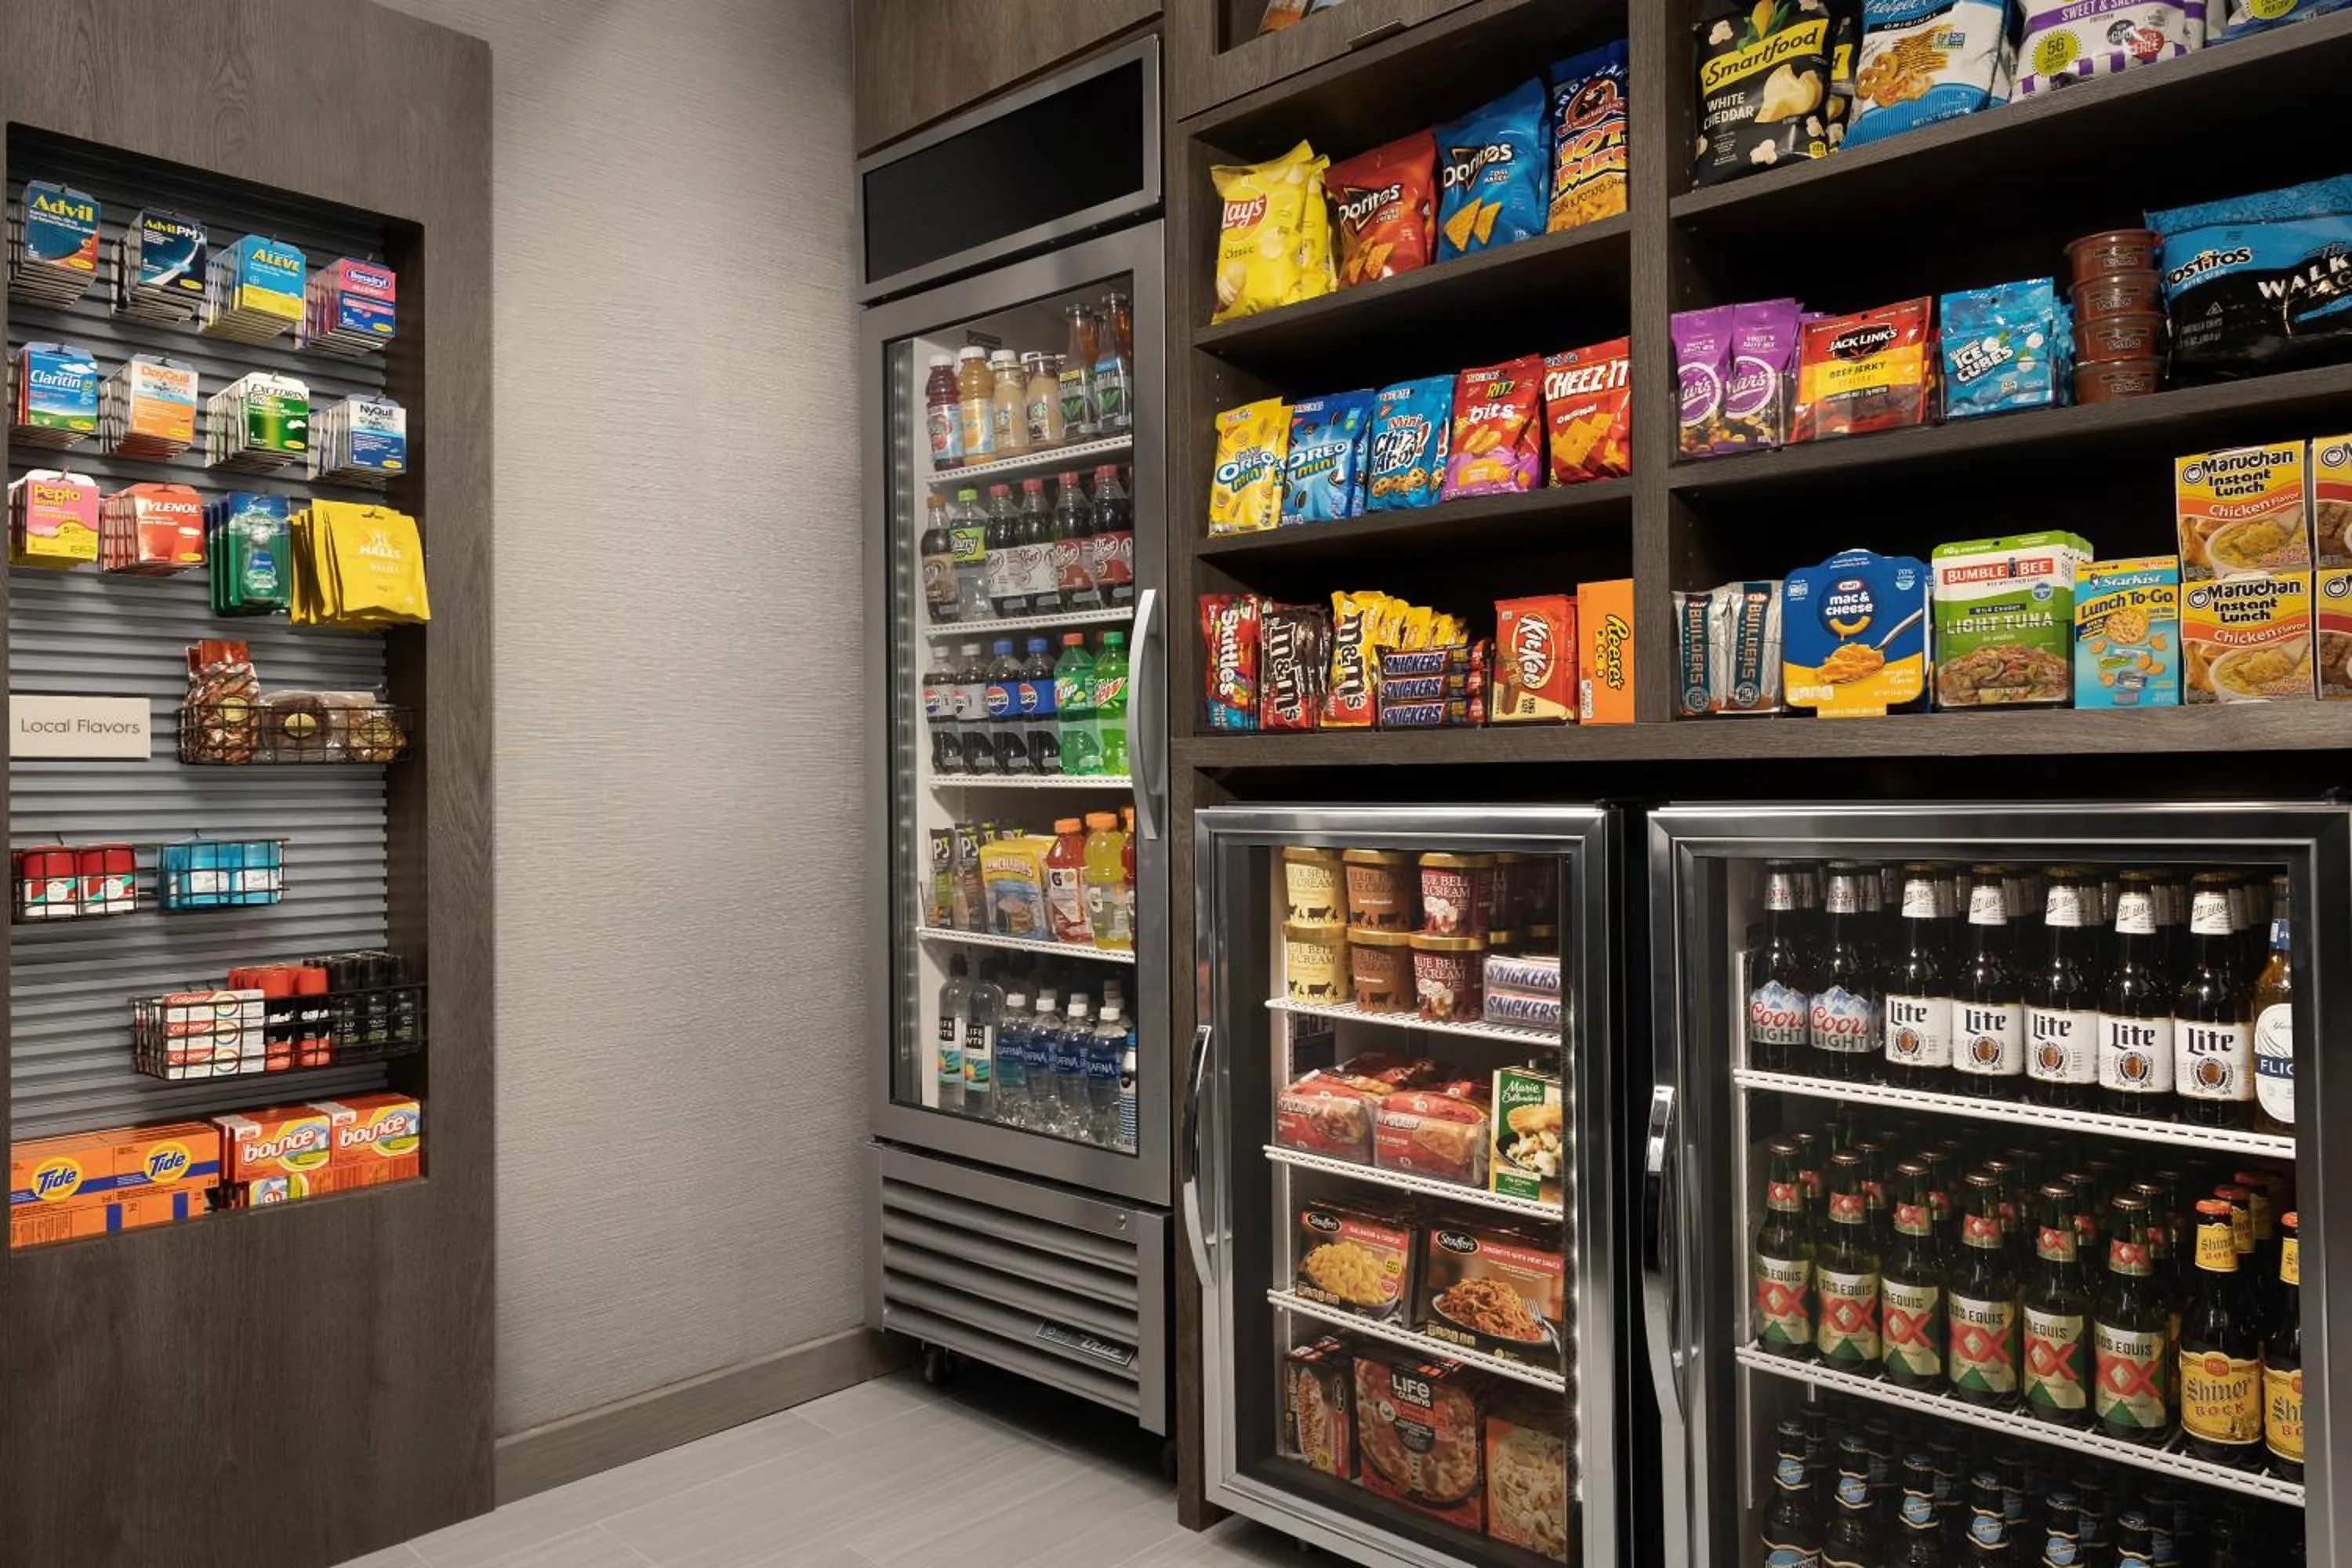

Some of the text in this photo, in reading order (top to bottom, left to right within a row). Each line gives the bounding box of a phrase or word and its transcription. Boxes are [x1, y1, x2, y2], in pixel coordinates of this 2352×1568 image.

[2061, 1, 2096, 22] SWEET
[1704, 27, 1818, 88] Smartfood
[1707, 90, 1745, 112] WHITE
[1704, 107, 1755, 131] CHEDDAR
[1443, 143, 1513, 187] Doritos
[32, 194, 93, 221] Advil
[1338, 184, 1402, 222] Doritos
[251, 249, 300, 271] ALEVE
[1828, 328, 1897, 352] JACK LINK'S
[1953, 346, 1984, 369] ICE
[1957, 345, 2014, 383] CUBES
[31, 369, 82, 389] Claritin
[141, 365, 190, 384] DayQuil
[1544, 359, 1629, 401] CHEEZ-IT
[1486, 380, 1515, 399] RITZ
[360, 405, 393, 418] NyQuil
[1469, 403, 1515, 424] bits
[1218, 450, 1275, 482] OREO
[1287, 442, 1347, 468] OREO
[2201, 449, 2294, 474] Maruchan
[1297, 456, 1336, 478] mini
[34, 484, 81, 502] Pepto
[2215, 481, 2265, 497] Lunch
[2209, 498, 2271, 517] Chicken
[1947, 559, 2050, 584] BUMBLE BEE
[1829, 593, 1871, 604] mac &
[2206, 579, 2301, 599] Maruchan
[2081, 593, 2126, 619] Lunch
[2213, 596, 2278, 612] Instant
[1947, 612, 2053, 635] LIGHT TUNA
[2220, 610, 2271, 623] Lunch
[1741, 603, 1759, 679] BUILDERS
[2213, 626, 2277, 644] Chicken
[1219, 608, 1240, 696] Skittles
[1383, 652, 1443, 675] SNICKERS
[1605, 614, 1632, 691] Reese's
[1382, 679, 1441, 699] SNICKERS
[1382, 704, 1439, 725] SNICKERS
[21, 718, 141, 735] Local Flavors
[933, 837, 949, 860] P3
[960, 834, 979, 859] P3
[1051, 872, 1062, 887] G
[1436, 957, 1466, 969] BELL
[1490, 963, 1559, 989] SNICKERS
[1489, 995, 1560, 1020] SNICKERS
[1751, 1000, 1807, 1027] Coors
[1889, 1000, 1927, 1025] Lite
[1810, 1005, 1870, 1034] Coors
[1964, 1008, 2006, 1034] Lite
[2032, 1013, 2072, 1040] Lite
[1813, 1033, 1867, 1049] LIGHT
[2111, 1022, 2156, 1050] Lite
[2187, 1027, 2234, 1056] Lite
[1505, 1080, 1541, 1094] Marie
[339, 1113, 407, 1147] bounce
[243, 1128, 315, 1164] bounce
[150, 1152, 187, 1178] Tide
[37, 1167, 77, 1195] Tide
[1440, 1232, 1477, 1252] Stouffer's
[1771, 1267, 1802, 1282] EQUIS
[1840, 1280, 1872, 1297] EQUIS
[1890, 1292, 1924, 1309] EQUIS
[1968, 1307, 2004, 1325] EQUIS
[2033, 1321, 2067, 1340] EQUIS
[2115, 1340, 2153, 1357] EQUIS
[2186, 1378, 2249, 1403] Shiner
